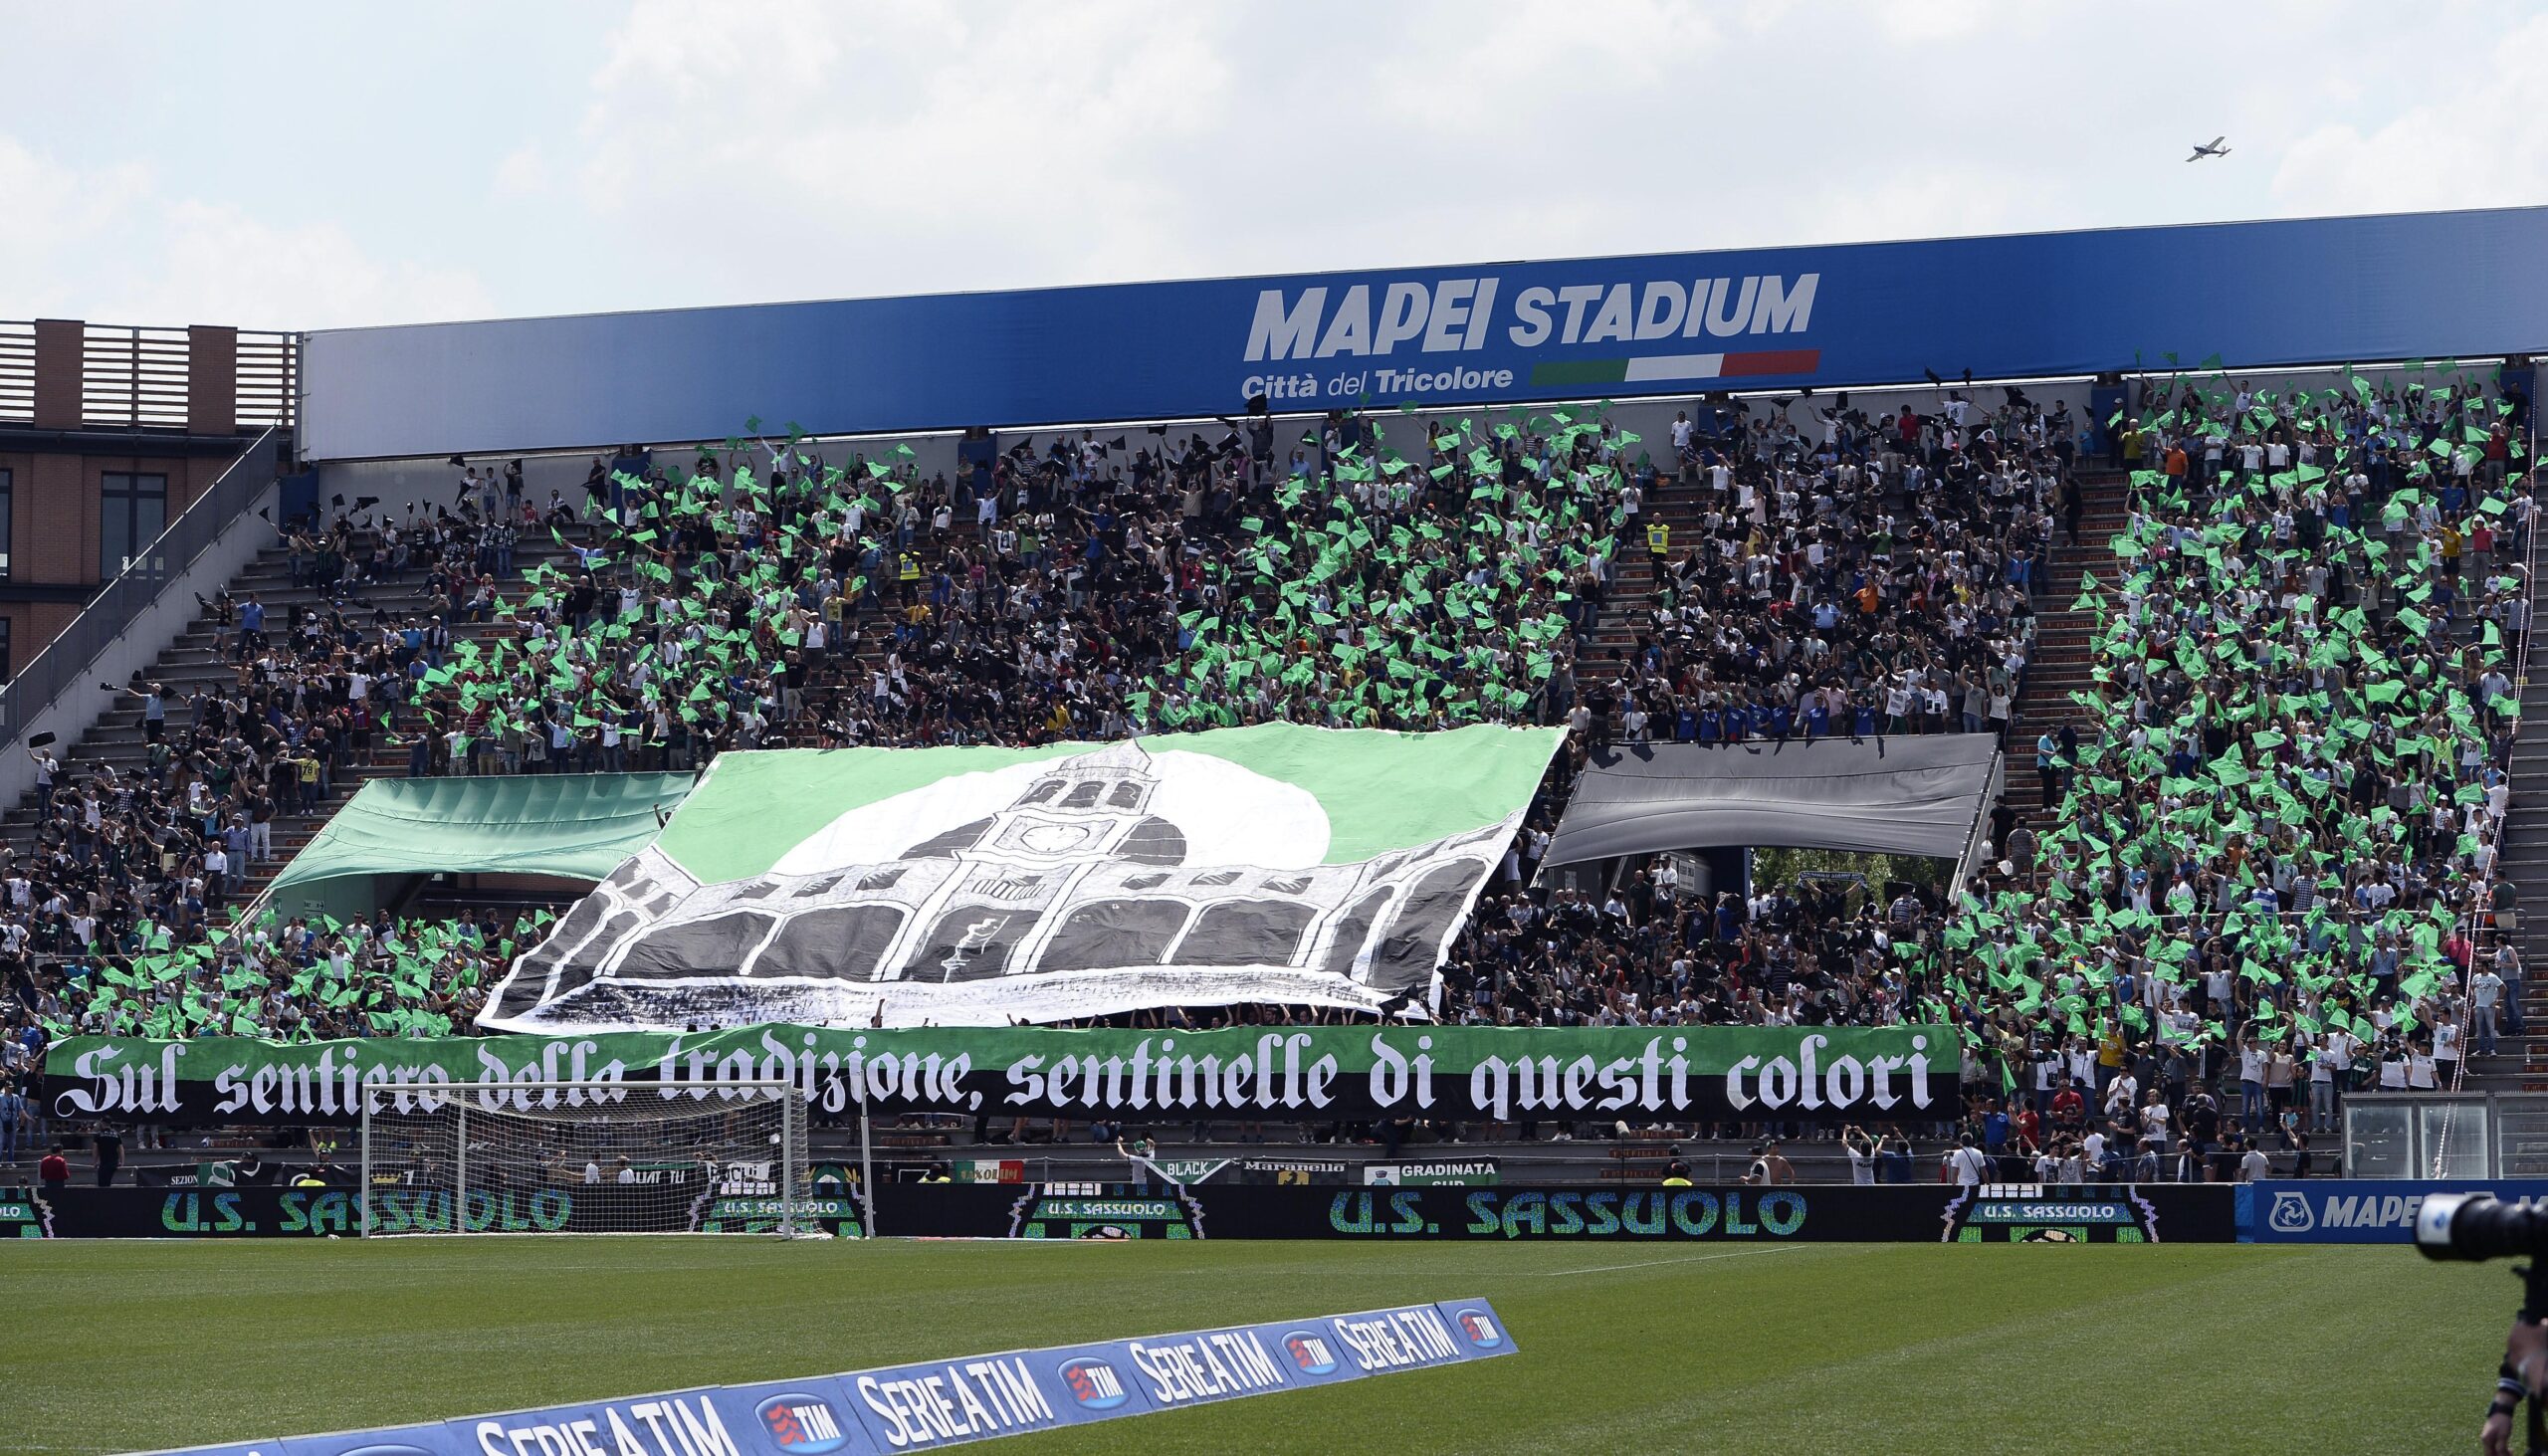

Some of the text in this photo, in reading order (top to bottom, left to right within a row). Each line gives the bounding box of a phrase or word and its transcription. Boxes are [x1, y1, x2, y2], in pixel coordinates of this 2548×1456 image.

[1243, 273, 1820, 361] MAPEI STADIUM
[1241, 366, 1513, 399] Città del Tricolore
[55, 1029, 1935, 1121] Sul sentiero della tradizione, sentinelle di questi colori
[1167, 1161, 1208, 1176] BLACK
[1244, 1161, 1345, 1172] Maranello
[1401, 1162, 1495, 1177] GRADINATA
[161, 1191, 573, 1236] U.S. SASSUOLO
[1048, 1202, 1166, 1216] U.S. SASSUOLO
[1330, 1191, 1807, 1239] U.S. SASSUOLO
[1984, 1205, 2115, 1219] U.S. SASSUOLO
[2321, 1195, 2427, 1228] MAPE
[1472, 1315, 1500, 1342] TIM
[1304, 1339, 1335, 1366] TIM
[1085, 1365, 1127, 1398] TIM
[792, 1404, 842, 1442] TIM
